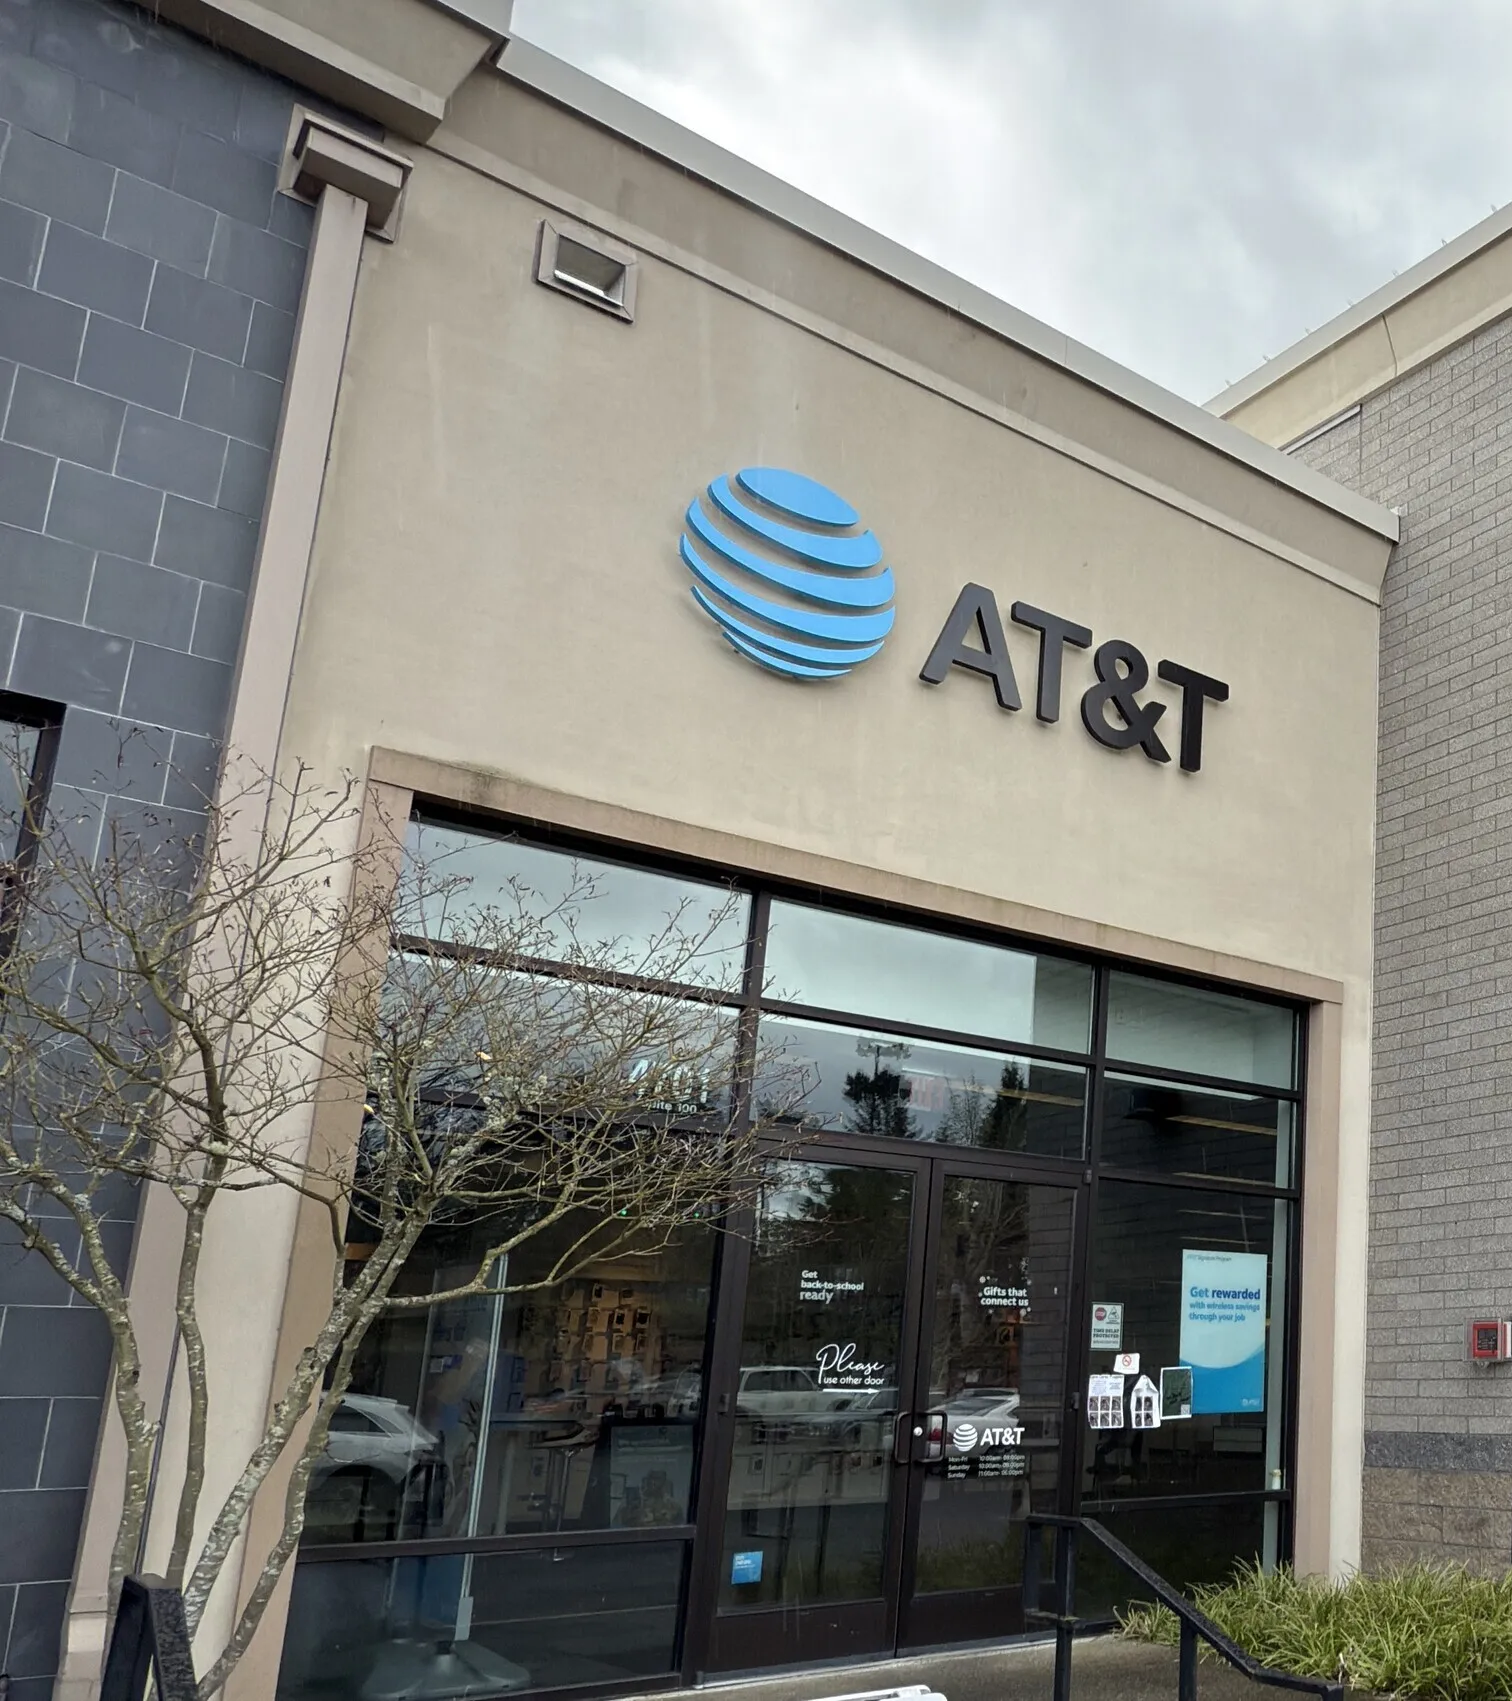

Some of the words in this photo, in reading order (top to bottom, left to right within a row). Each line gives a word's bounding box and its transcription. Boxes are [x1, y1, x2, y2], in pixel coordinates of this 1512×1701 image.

[919, 582, 1229, 773] AT&T
[802, 1270, 818, 1279] Get
[801, 1280, 865, 1291] back-to-school
[800, 1290, 834, 1304] ready
[983, 1286, 1007, 1296] Gifts
[1008, 1287, 1027, 1297] that
[1190, 1286, 1209, 1298] Get
[1211, 1288, 1261, 1300] rewarded
[980, 1297, 1017, 1306] connect
[1018, 1298, 1029, 1306] us
[1189, 1301, 1206, 1309] with
[1189, 1312, 1217, 1322] through
[1218, 1314, 1233, 1322] your
[1234, 1313, 1246, 1322] job
[816, 1343, 885, 1384] Please
[823, 1376, 838, 1384] use
[840, 1375, 862, 1385] other
[864, 1376, 885, 1385] door
[980, 1427, 1025, 1446] AT&T
